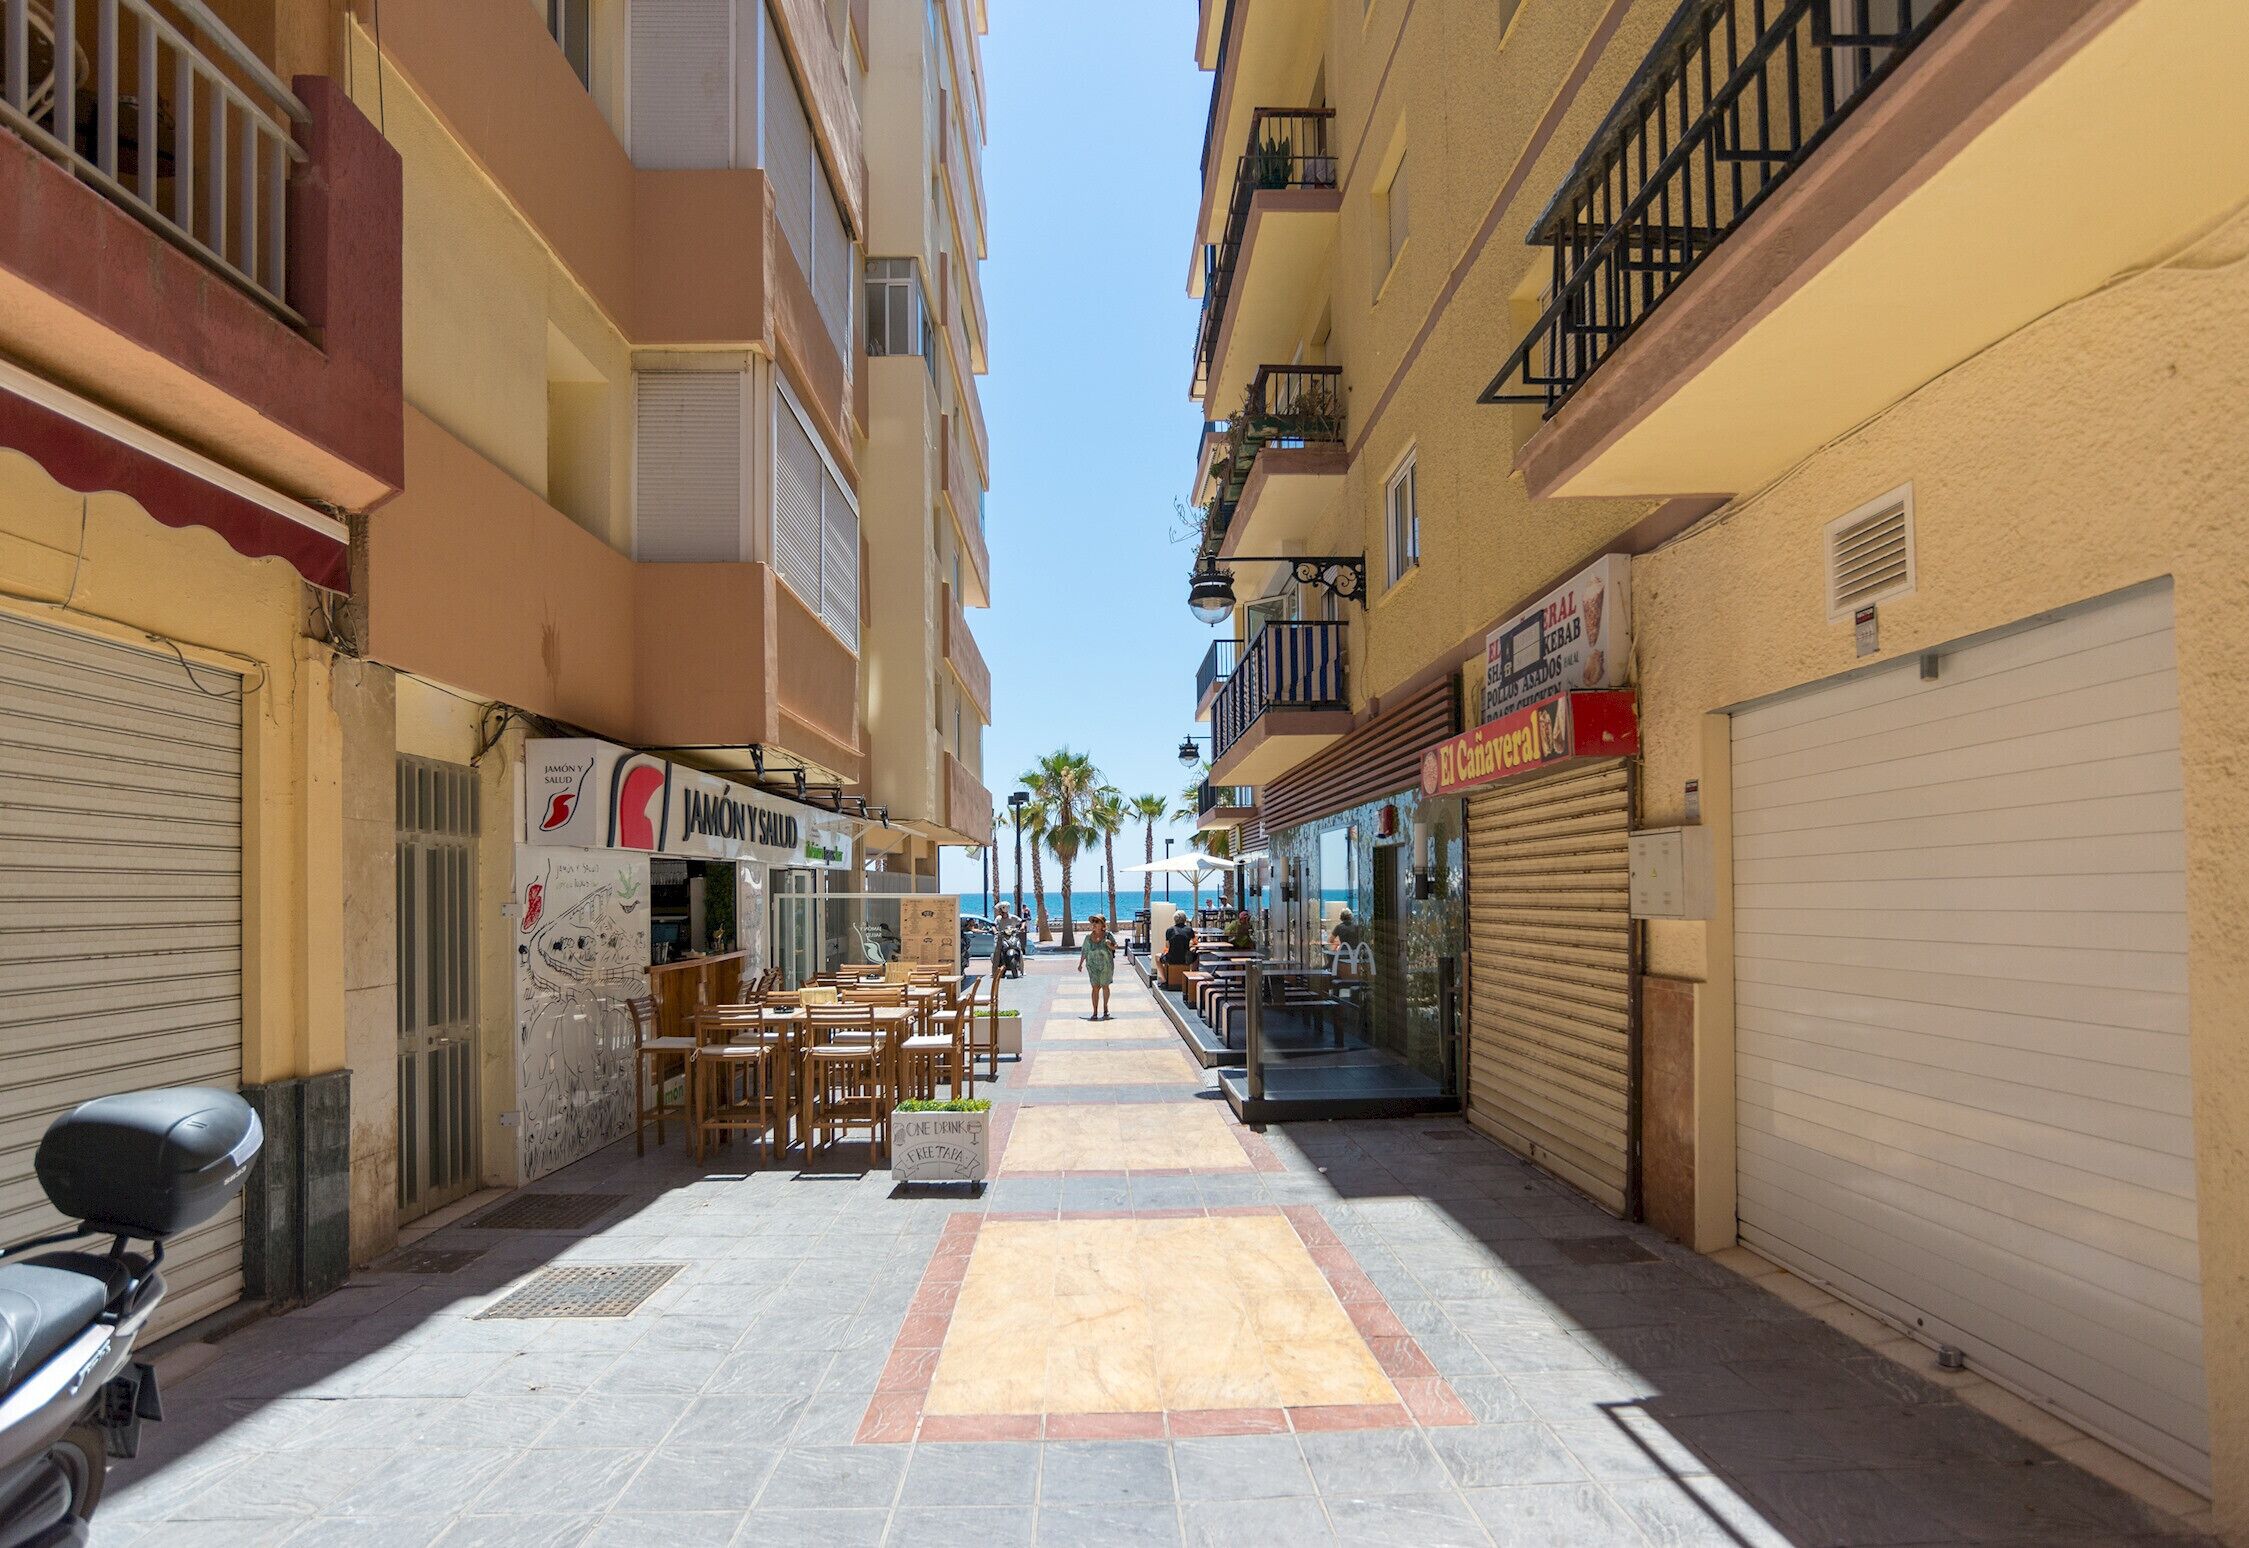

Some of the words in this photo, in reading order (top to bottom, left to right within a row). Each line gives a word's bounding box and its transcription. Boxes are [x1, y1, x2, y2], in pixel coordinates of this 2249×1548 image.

[1440, 744, 1455, 787] El
[1457, 709, 1541, 782] Cañaveral
[544, 762, 576, 775] JAMÓN
[577, 765, 584, 773] Y
[544, 776, 573, 784] SALUD
[683, 783, 746, 842] JAMÓN
[747, 804, 758, 843] Y
[759, 808, 799, 849] SALUD
[906, 1121, 931, 1137] ONE
[934, 1120, 969, 1136] DRINK
[907, 1145, 935, 1164] FREE
[935, 1145, 963, 1162] TAPA
